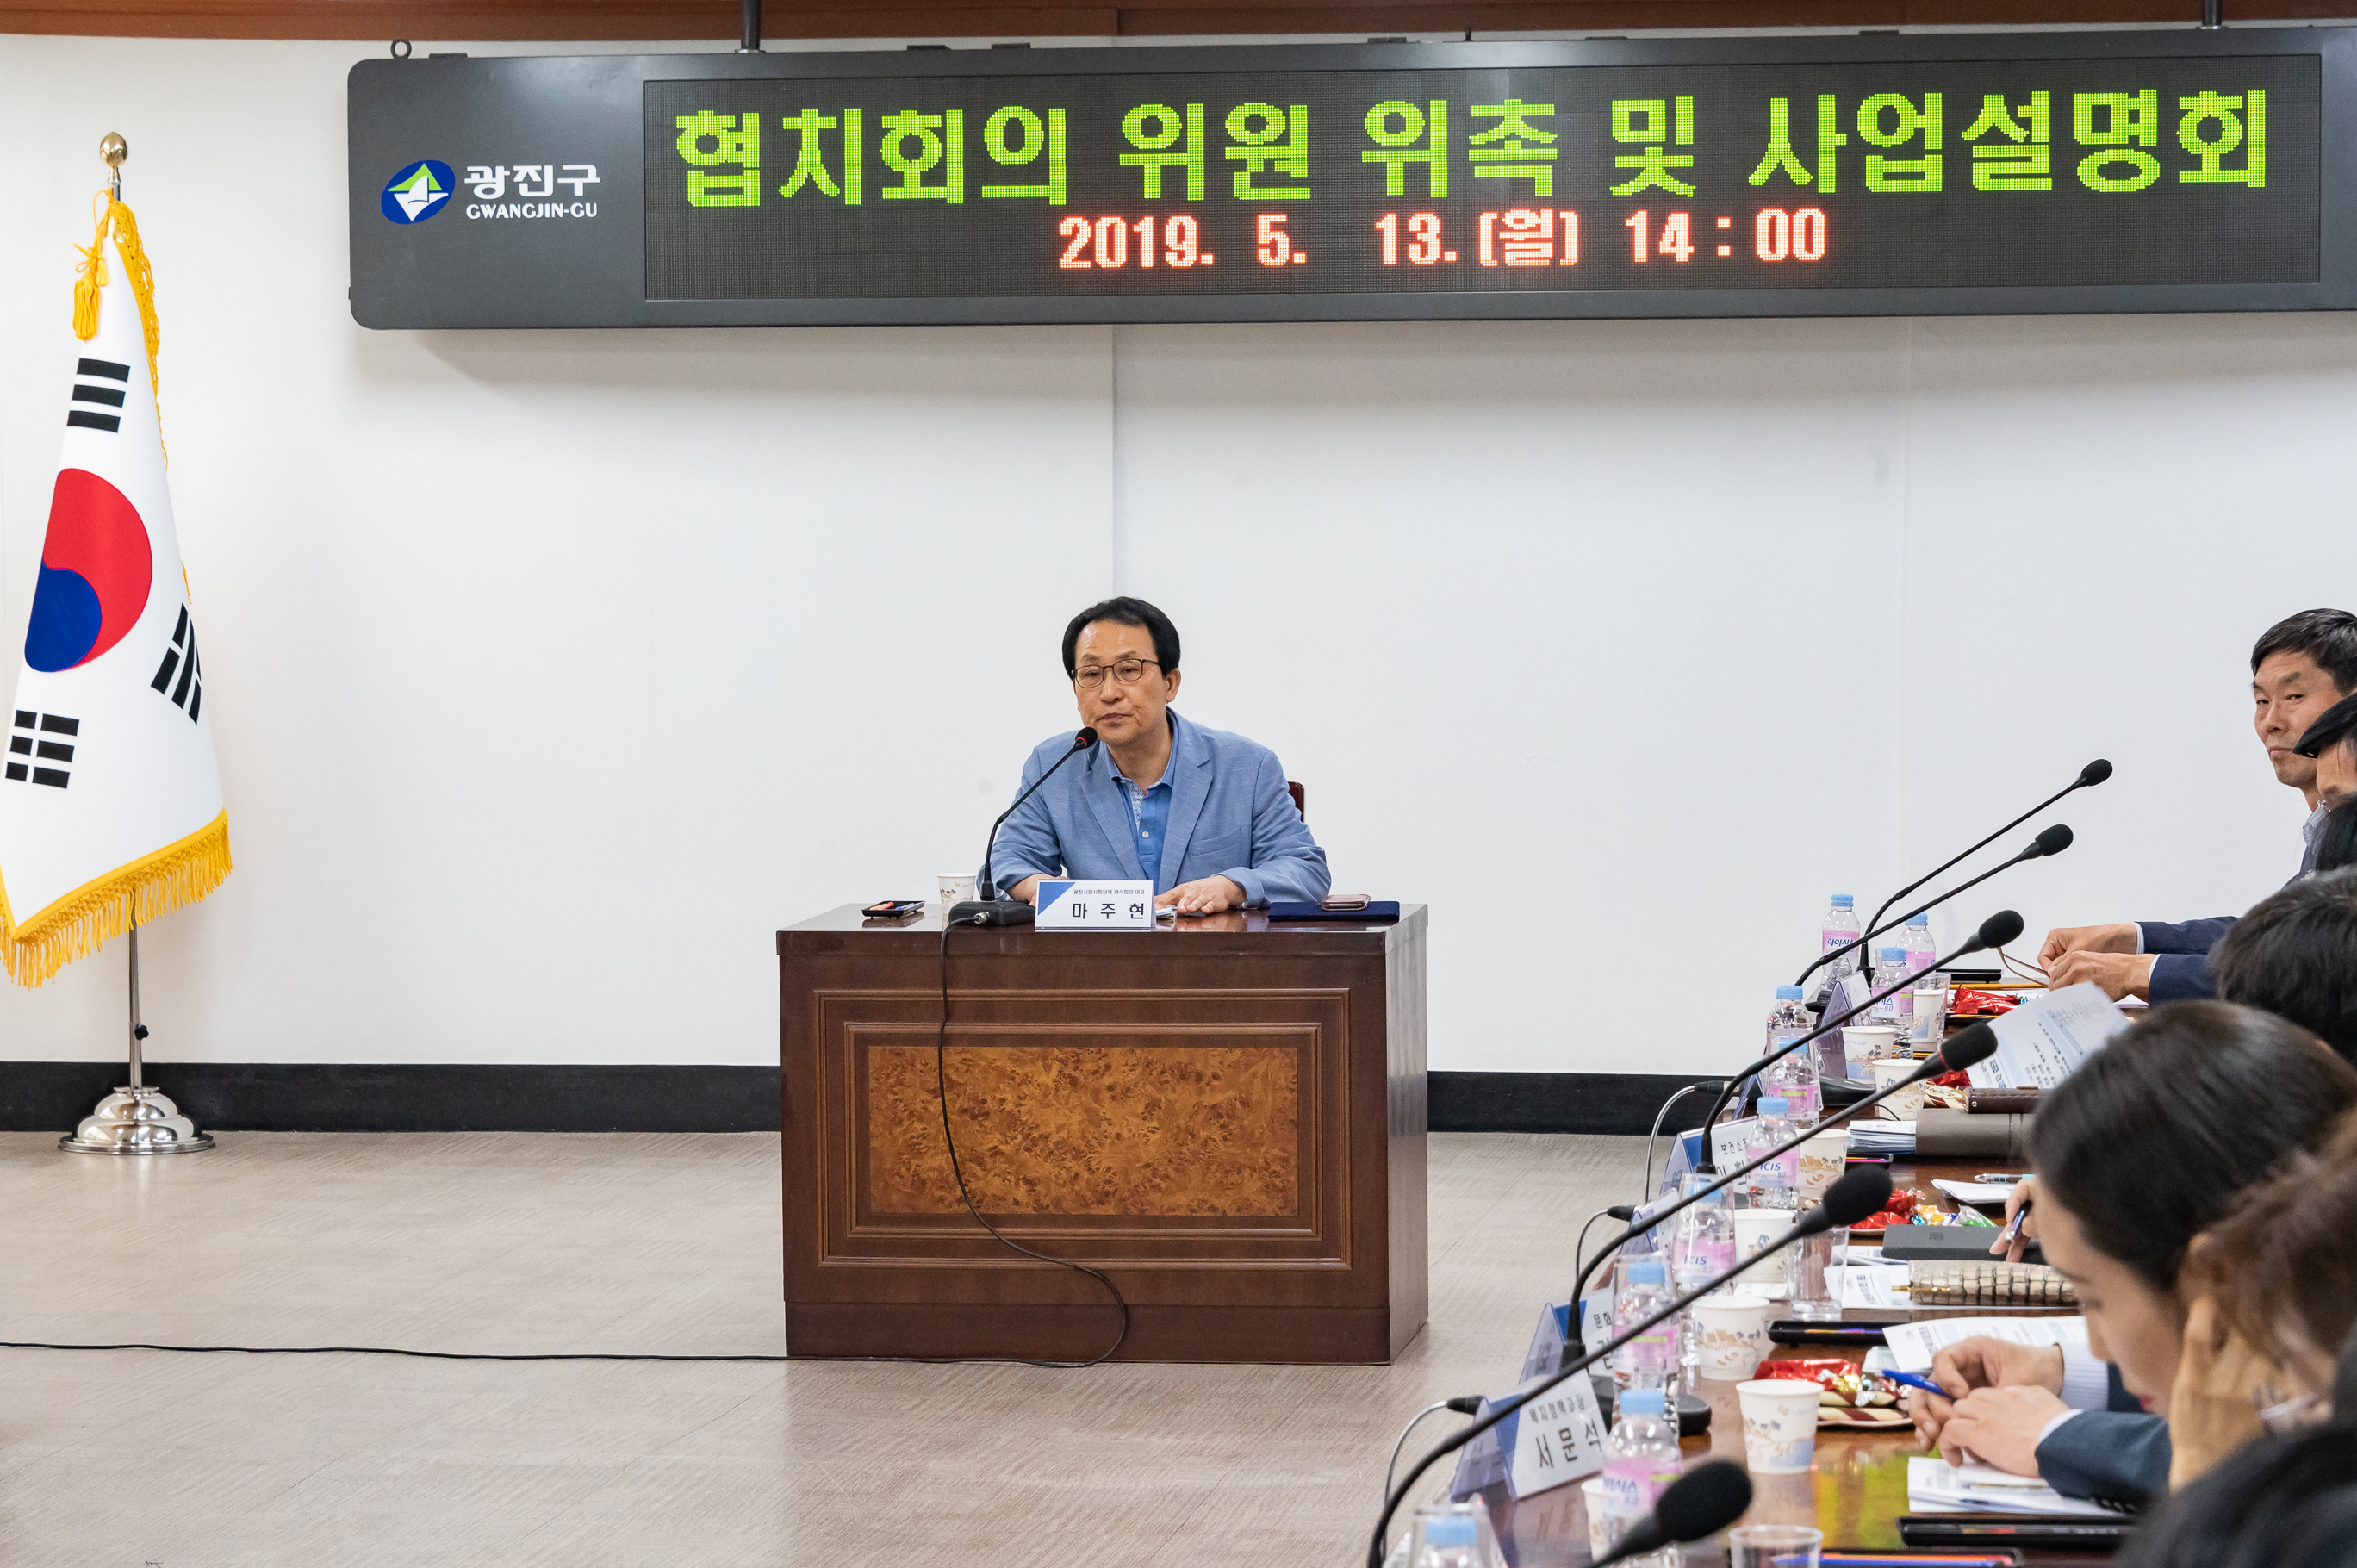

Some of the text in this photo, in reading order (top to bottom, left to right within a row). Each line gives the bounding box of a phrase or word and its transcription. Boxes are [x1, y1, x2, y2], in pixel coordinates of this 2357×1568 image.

[676, 88, 2267, 208] 협치회의 위원 위촉 및 사업설명회
[464, 164, 601, 200] 광진구
[466, 202, 598, 220] GWANGJIN-GU
[1059, 212, 1215, 271] 2019.
[1255, 213, 1308, 268] 5.
